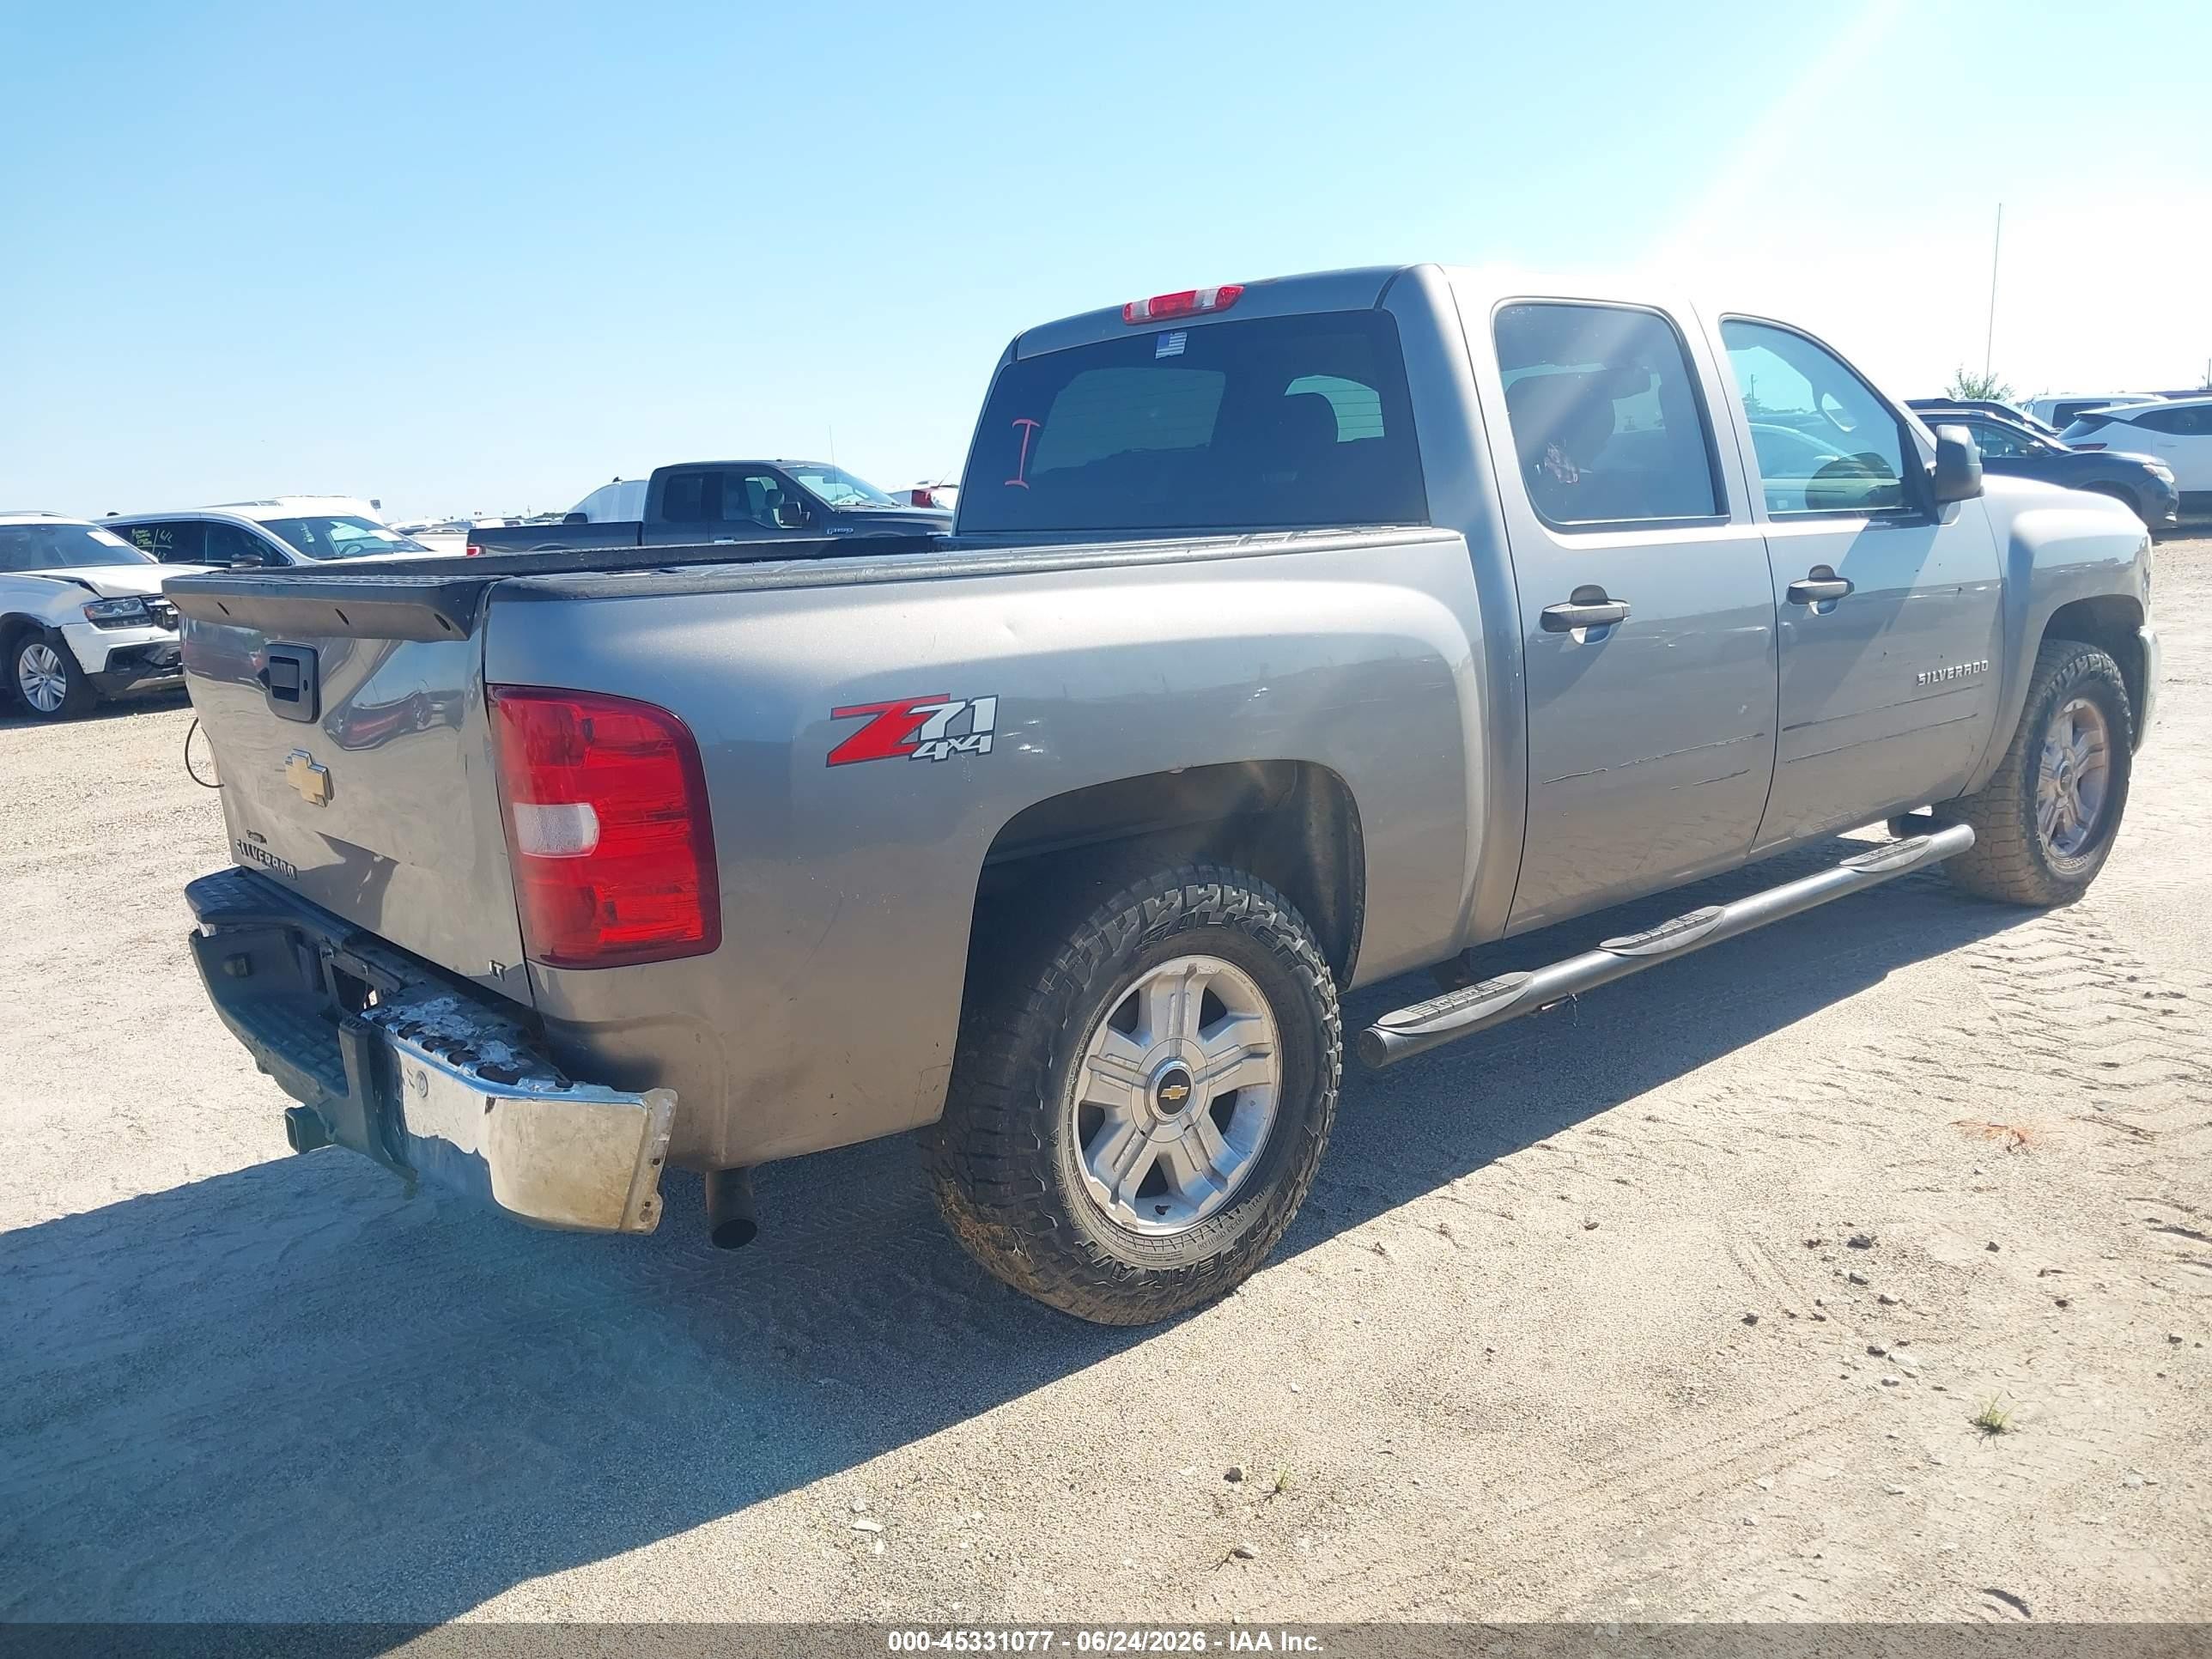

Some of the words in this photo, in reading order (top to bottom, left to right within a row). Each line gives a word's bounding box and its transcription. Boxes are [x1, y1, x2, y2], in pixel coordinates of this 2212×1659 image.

[1917, 659, 1989, 686] SILVERADO
[826, 693, 1000, 767] Z71
[236, 838, 298, 881] SILVERADO
